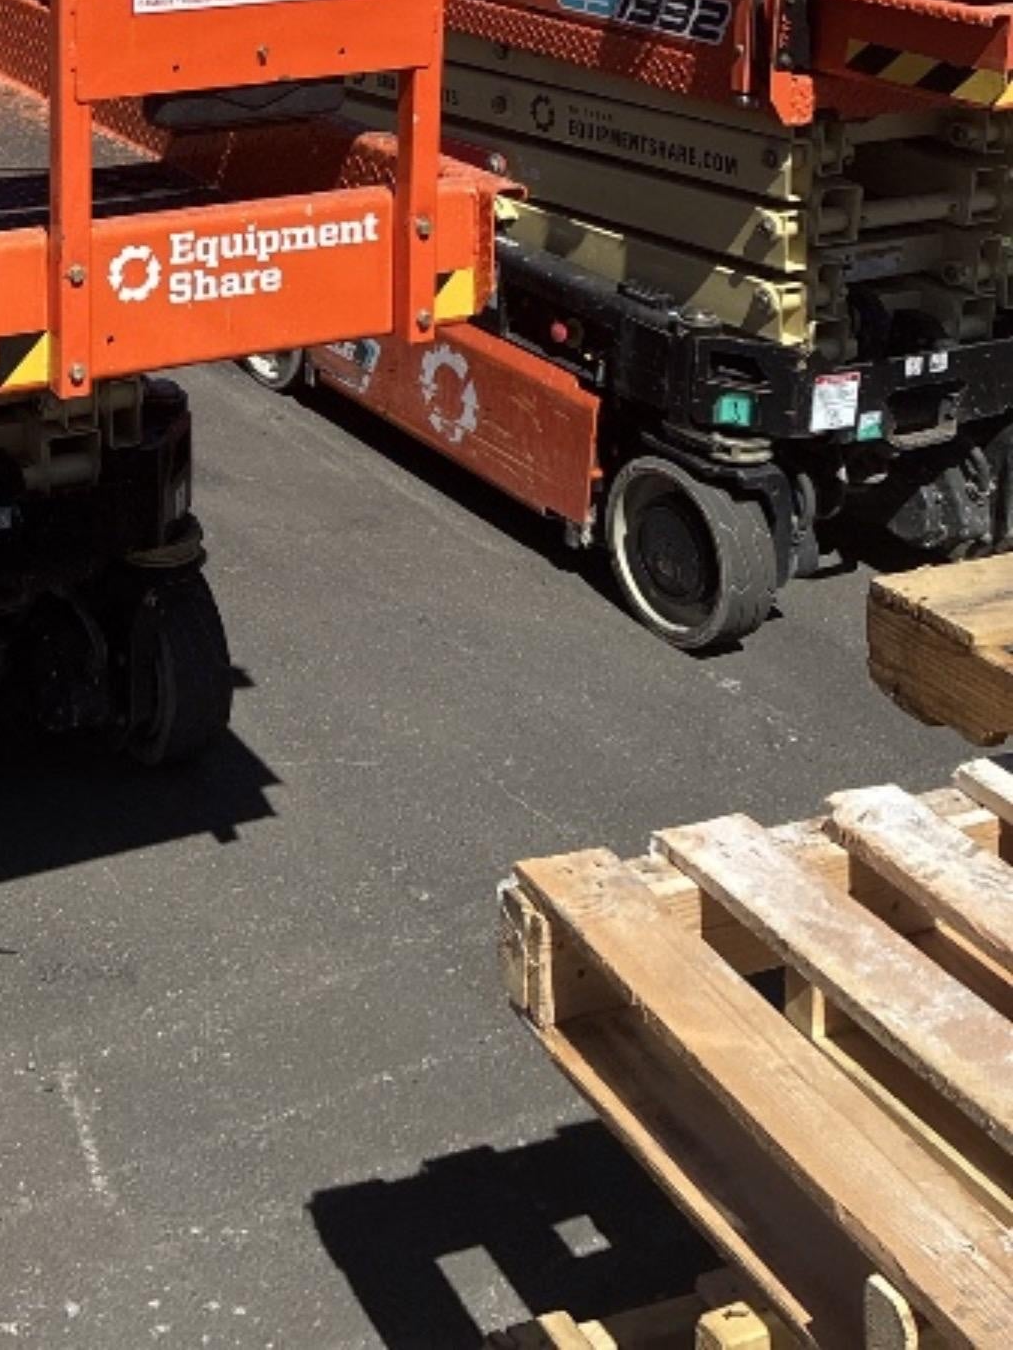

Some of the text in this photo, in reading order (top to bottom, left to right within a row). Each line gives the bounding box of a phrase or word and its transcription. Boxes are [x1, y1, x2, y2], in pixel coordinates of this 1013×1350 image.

[567, 118, 738, 175] EQUIPMENTSHARE.COM
[169, 212, 379, 269] Equipment
[169, 267, 282, 304] Share
